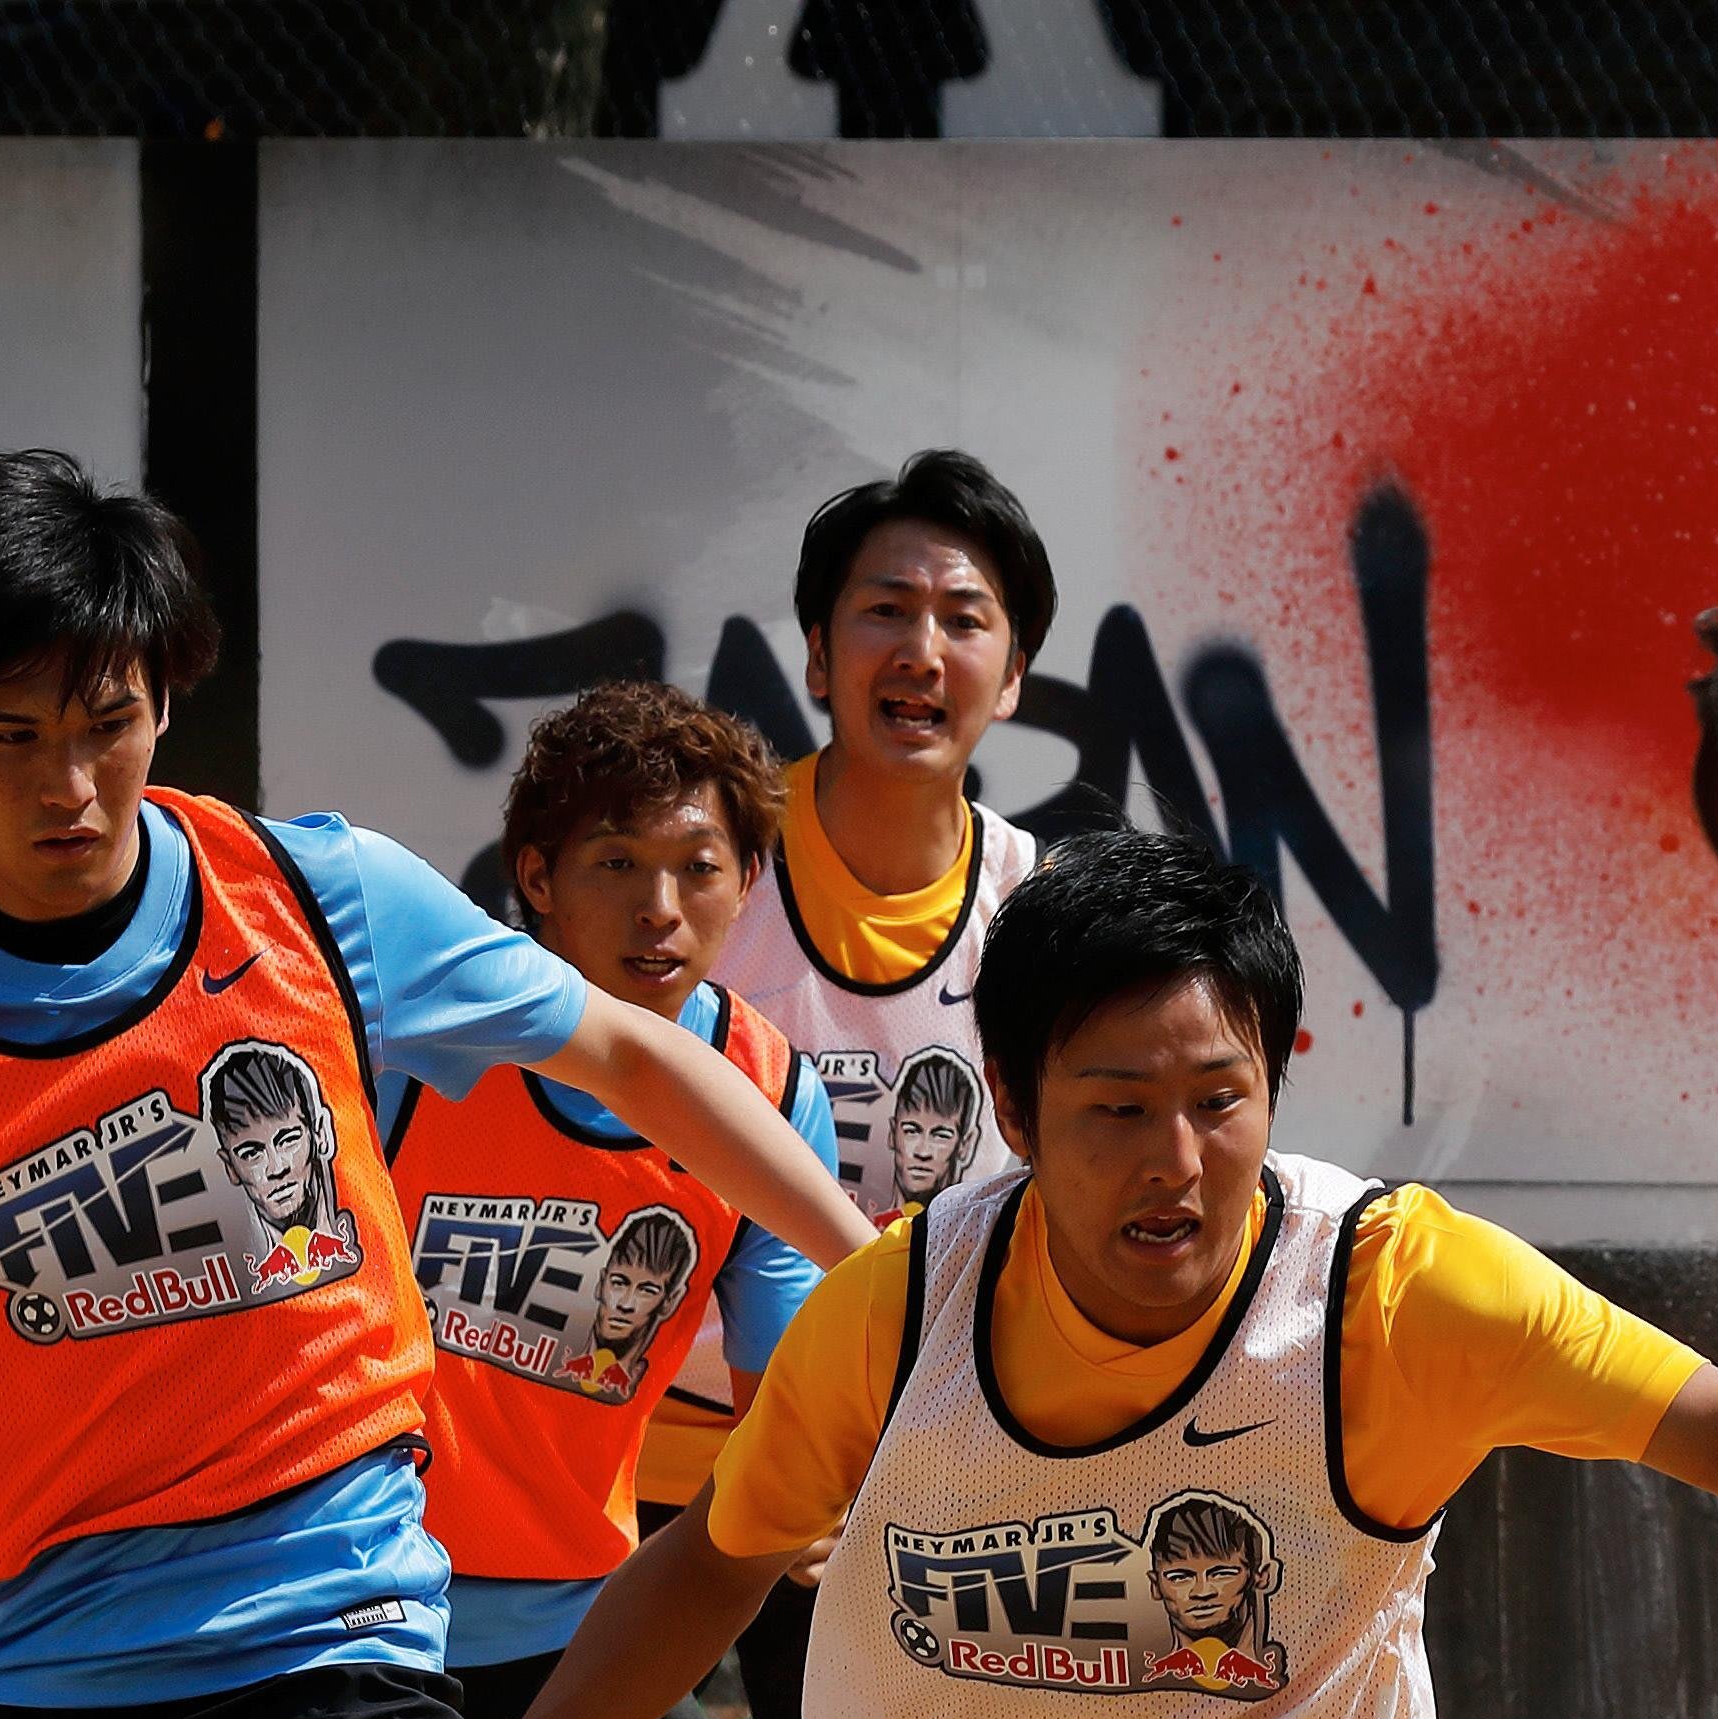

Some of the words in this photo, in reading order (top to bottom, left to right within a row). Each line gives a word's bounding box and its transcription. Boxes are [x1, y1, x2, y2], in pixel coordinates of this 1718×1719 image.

[106, 1096, 167, 1145] JR'S
[428, 1199, 529, 1221] NEYMAR
[540, 1200, 593, 1225] JR'S
[67, 1272, 158, 1330] Red
[162, 1256, 240, 1311] Bull
[443, 1310, 495, 1353] Red
[495, 1322, 556, 1376] Bull
[893, 1531, 1024, 1553] NEYMAR
[1040, 1516, 1109, 1544] JR'S
[897, 1539, 1133, 1640] FIVE
[950, 1641, 1037, 1680] Red
[1044, 1644, 1129, 1688] Bull
